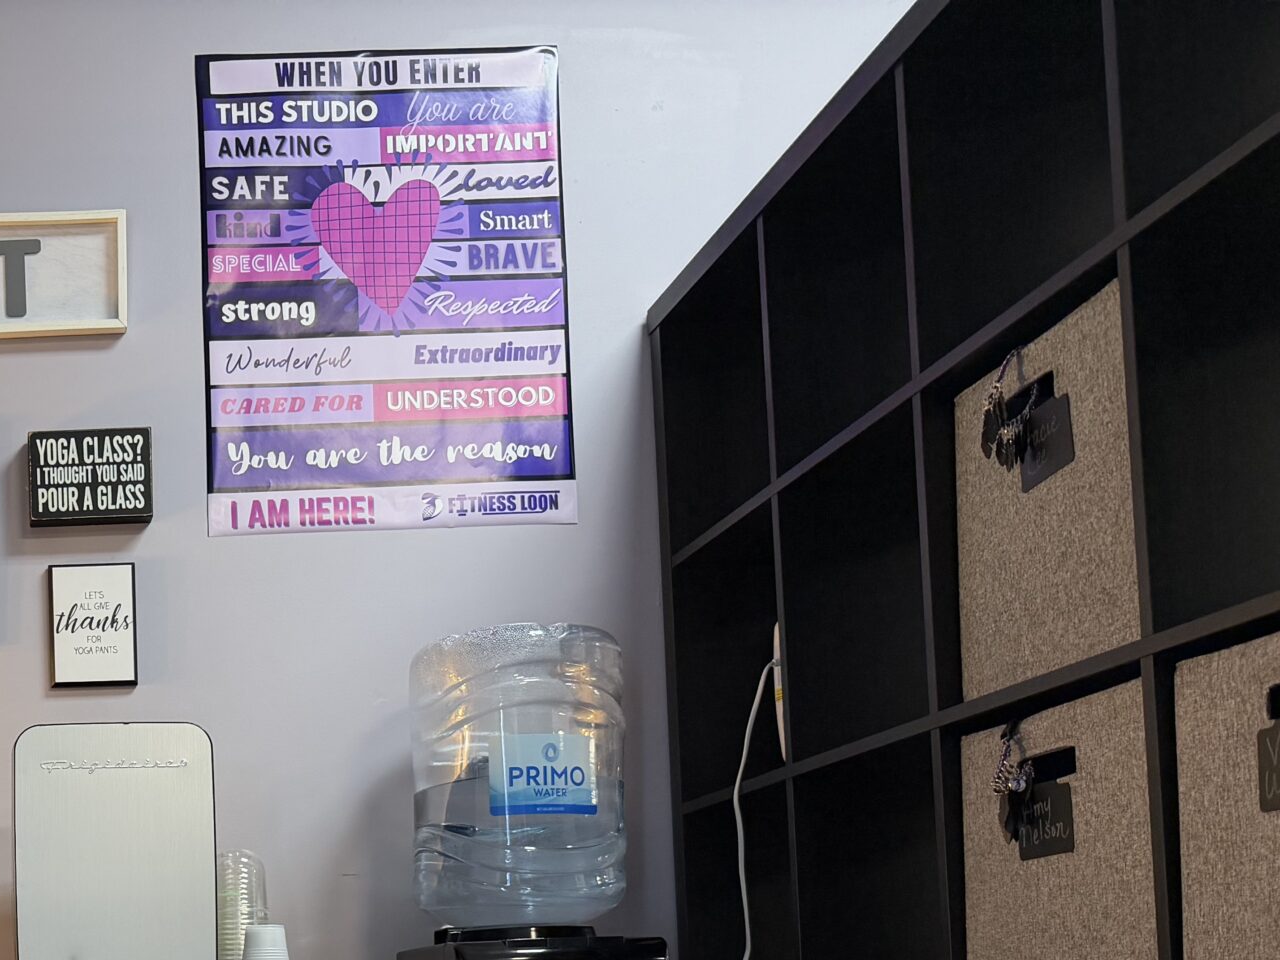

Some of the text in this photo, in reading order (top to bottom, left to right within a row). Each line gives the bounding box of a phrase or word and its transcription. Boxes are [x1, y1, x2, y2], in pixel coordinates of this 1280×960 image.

[275, 57, 482, 88] WHEN YOU ENTER
[215, 90, 515, 136] THIS STUDIO You are
[218, 131, 553, 158] AMAZING IMPORTANT
[211, 175, 289, 200] SAFE
[479, 208, 552, 231] Smart
[212, 242, 556, 273] SPECIAL BRAVE
[221, 289, 561, 326] strong Respected
[225, 341, 561, 376] Wonderful Extraordinary
[220, 386, 555, 415] CARED FOR UNDERSTOOD
[36, 434, 143, 465] YOGA CLASS?
[227, 436, 558, 475] You are the reason
[37, 463, 144, 485] I THOUGHT YOU SAID
[38, 484, 145, 512] POUR A GLASS
[230, 500, 238, 529] I
[248, 498, 290, 529] AM
[299, 495, 375, 527] HERE!
[448, 493, 517, 516] FITNESS
[80, 602, 110, 610] ALL GIVE
[84, 591, 104, 599] LET'S
[55, 603, 133, 634] thanks
[74, 645, 118, 655] YOGA PANTS
[86, 635, 101, 643] FOR
[508, 766, 585, 788] PRIMO
[533, 788, 568, 797] WATER
